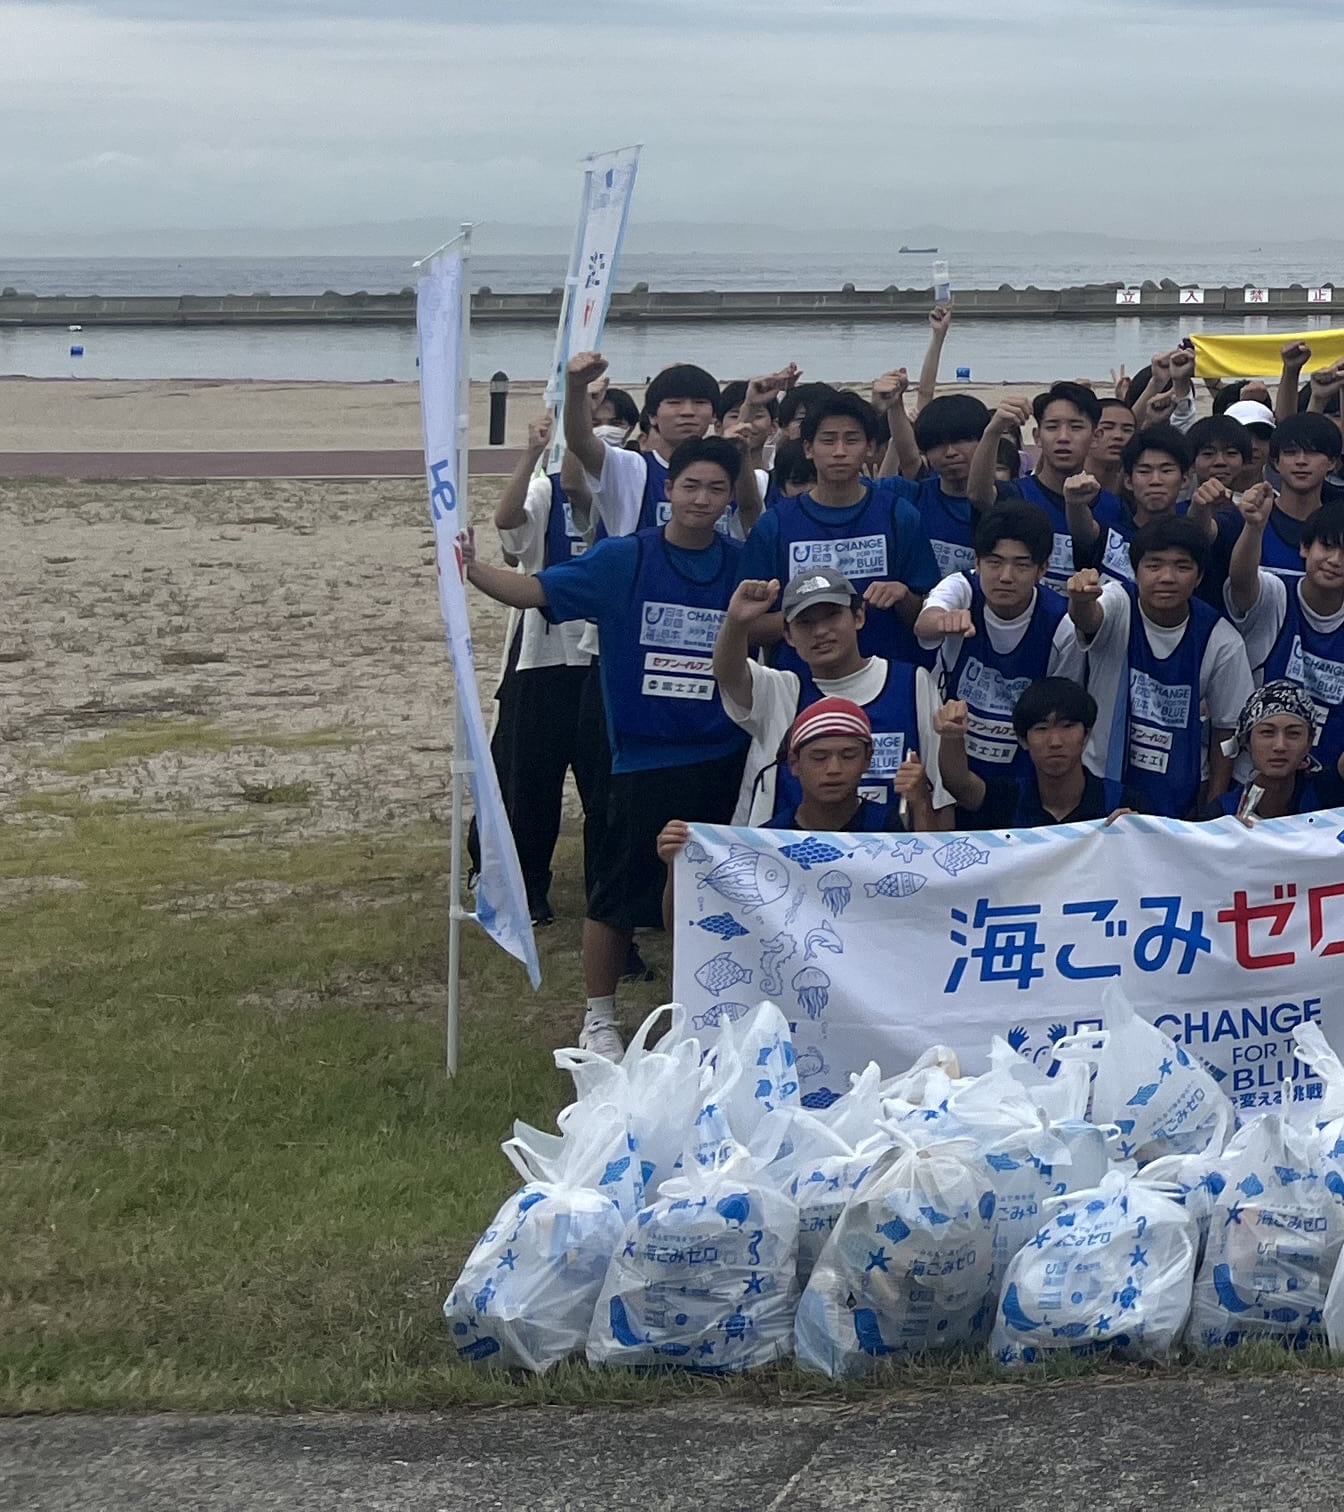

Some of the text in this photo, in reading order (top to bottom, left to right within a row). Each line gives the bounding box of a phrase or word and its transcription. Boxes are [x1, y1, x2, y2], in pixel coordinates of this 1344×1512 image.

[835, 538, 884, 553] CHANGE
[856, 555, 884, 568] BLUE
[1318, 680, 1343, 696] BLUE
[1161, 705, 1187, 718] BLUE
[1153, 998, 1322, 1045] CHANGE
[1232, 1044, 1277, 1065] FOR
